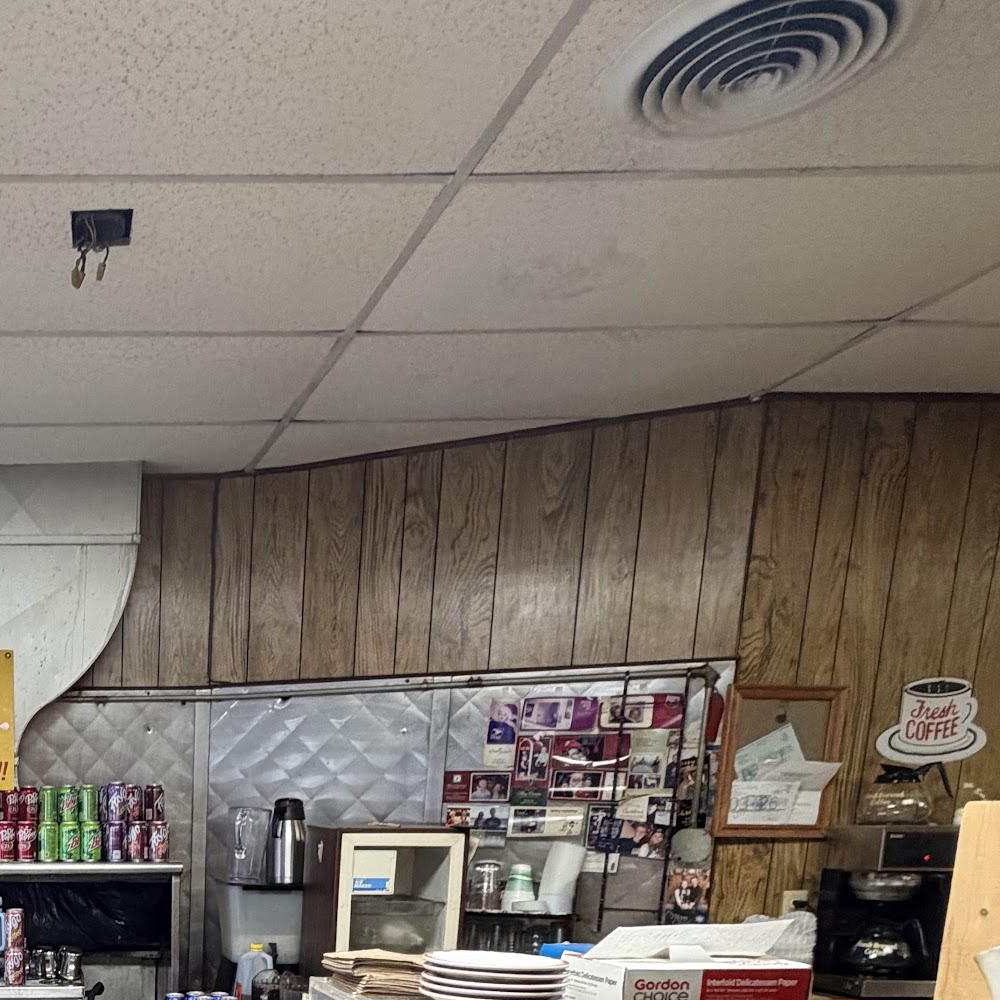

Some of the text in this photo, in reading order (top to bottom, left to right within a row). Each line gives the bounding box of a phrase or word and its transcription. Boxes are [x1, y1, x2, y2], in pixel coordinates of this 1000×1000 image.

[910, 699, 960, 720] Fresh
[905, 717, 960, 741] COFFEE
[634, 978, 690, 990] Gordon
